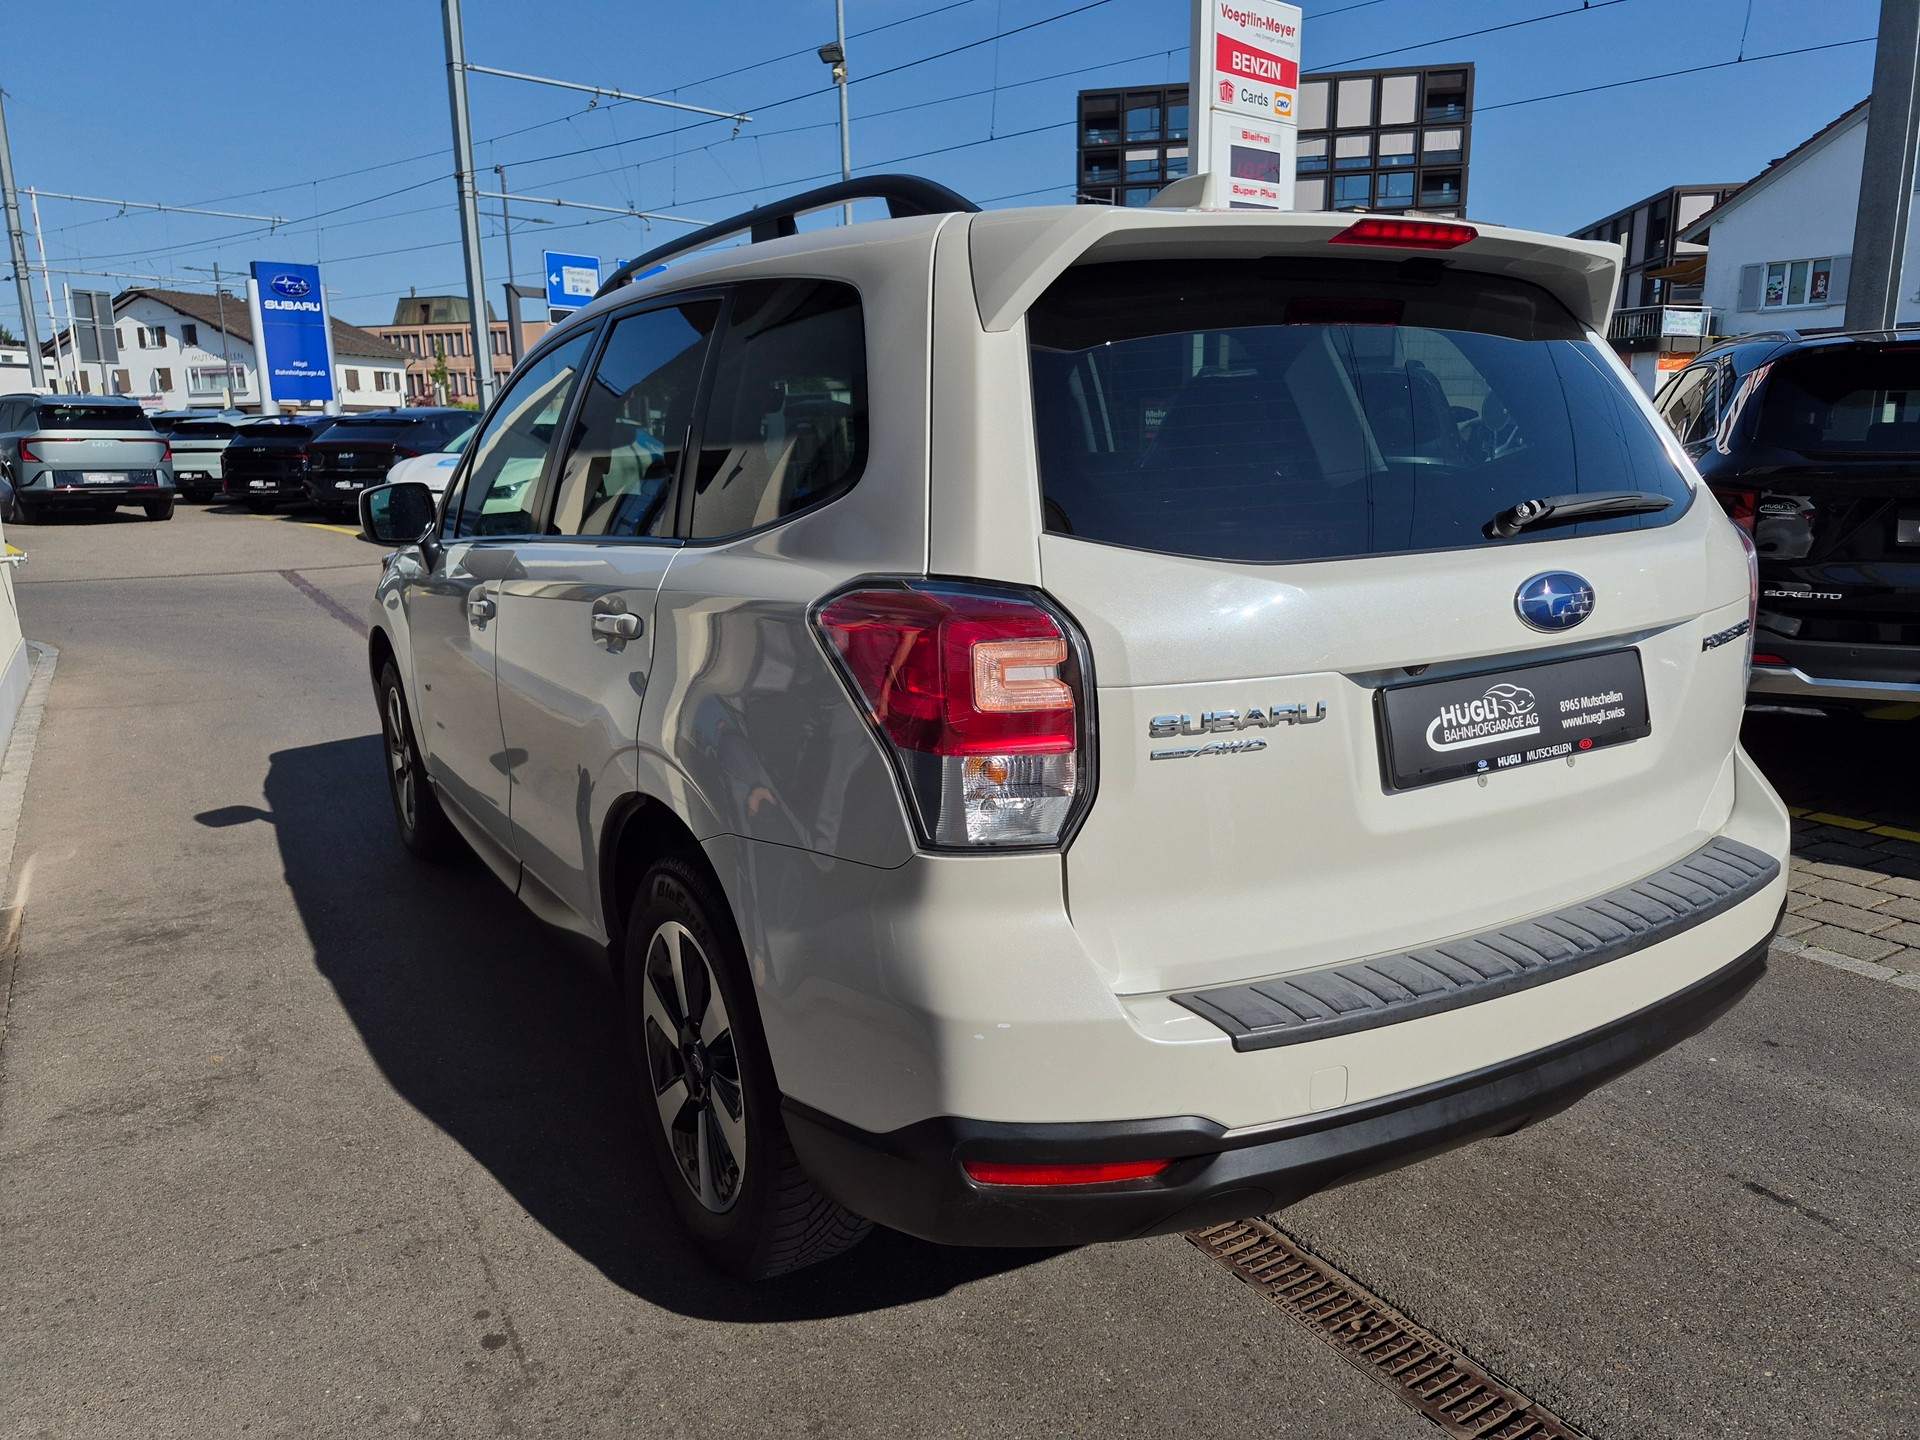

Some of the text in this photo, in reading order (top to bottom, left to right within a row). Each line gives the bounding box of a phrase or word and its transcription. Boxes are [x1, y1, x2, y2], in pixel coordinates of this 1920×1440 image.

[1221, 2, 1296, 38] Voegtlin-Meyer
[1232, 50, 1281, 80] BENZIN
[1241, 88, 1269, 107] Cards
[1276, 99, 1290, 109] DKV
[1241, 130, 1271, 143] Bleifrei
[1232, 184, 1277, 199] Super Plus
[264, 299, 321, 312] SUBARU
[1763, 589, 1843, 600] SORENTO
[1440, 696, 1499, 728] HÜGLI
[1559, 690, 1624, 713] 8965 Mutschellen
[1148, 700, 1327, 739] SUBARU
[1444, 712, 1539, 742] BAHNHOFGARAGE AG
[1561, 706, 1626, 729] www.huegli.swiss
[1526, 742, 1573, 762] MUTSCHELLEN
